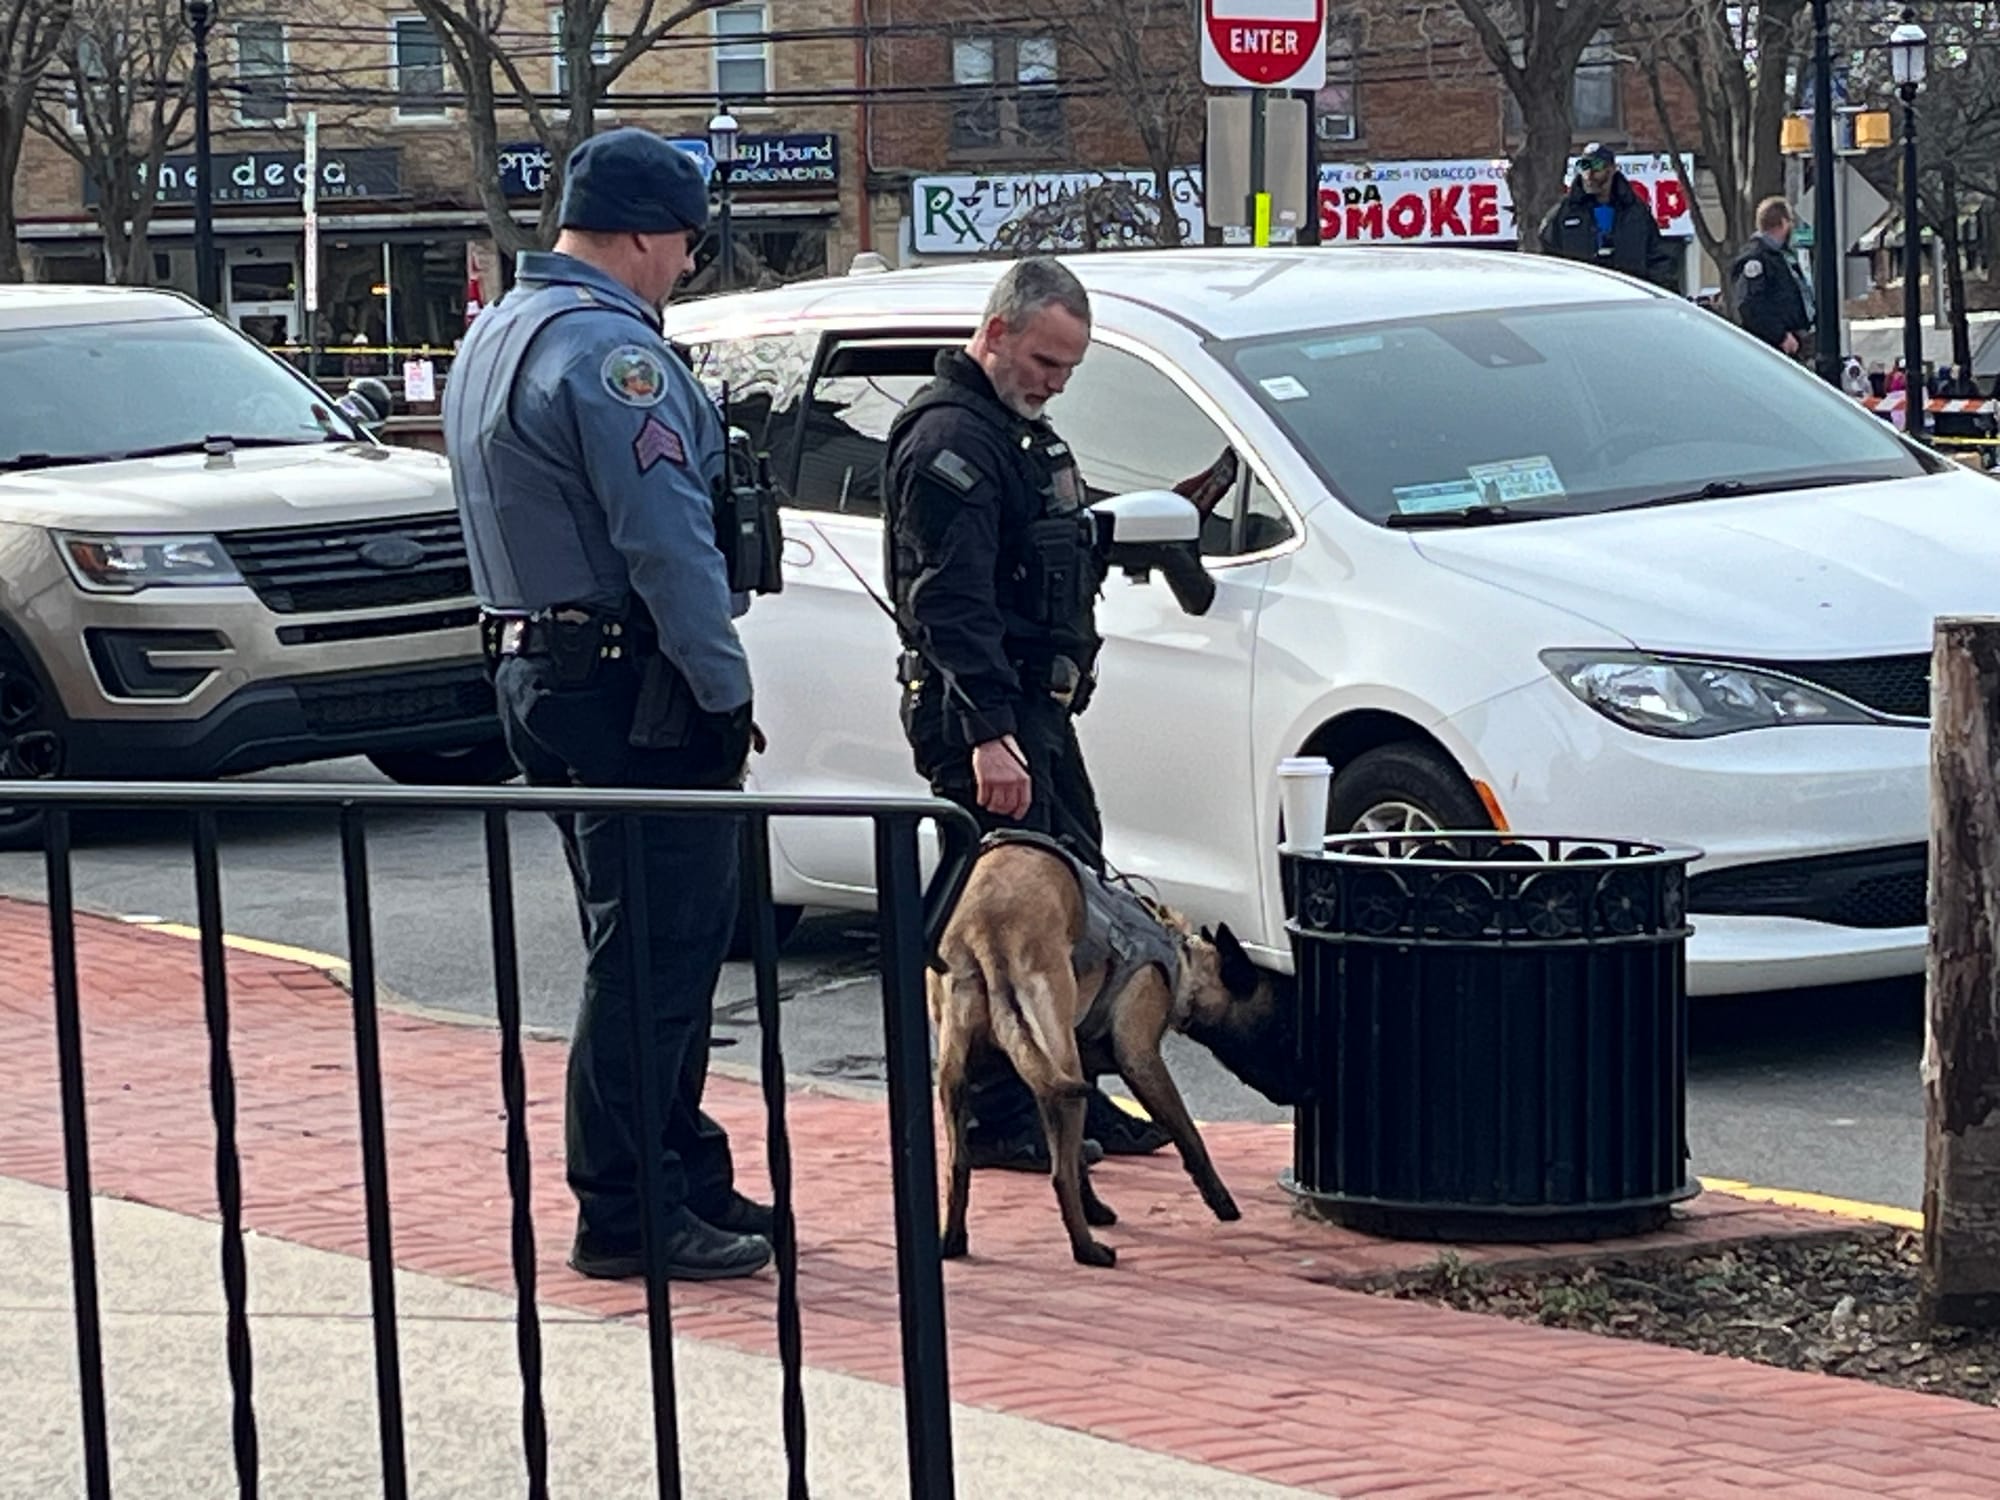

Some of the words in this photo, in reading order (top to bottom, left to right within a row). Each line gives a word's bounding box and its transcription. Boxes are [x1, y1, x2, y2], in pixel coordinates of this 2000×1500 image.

[1230, 27, 1299, 55] ENTER
[763, 136, 833, 163] Hound
[1318, 184, 1500, 240] SMOKE
